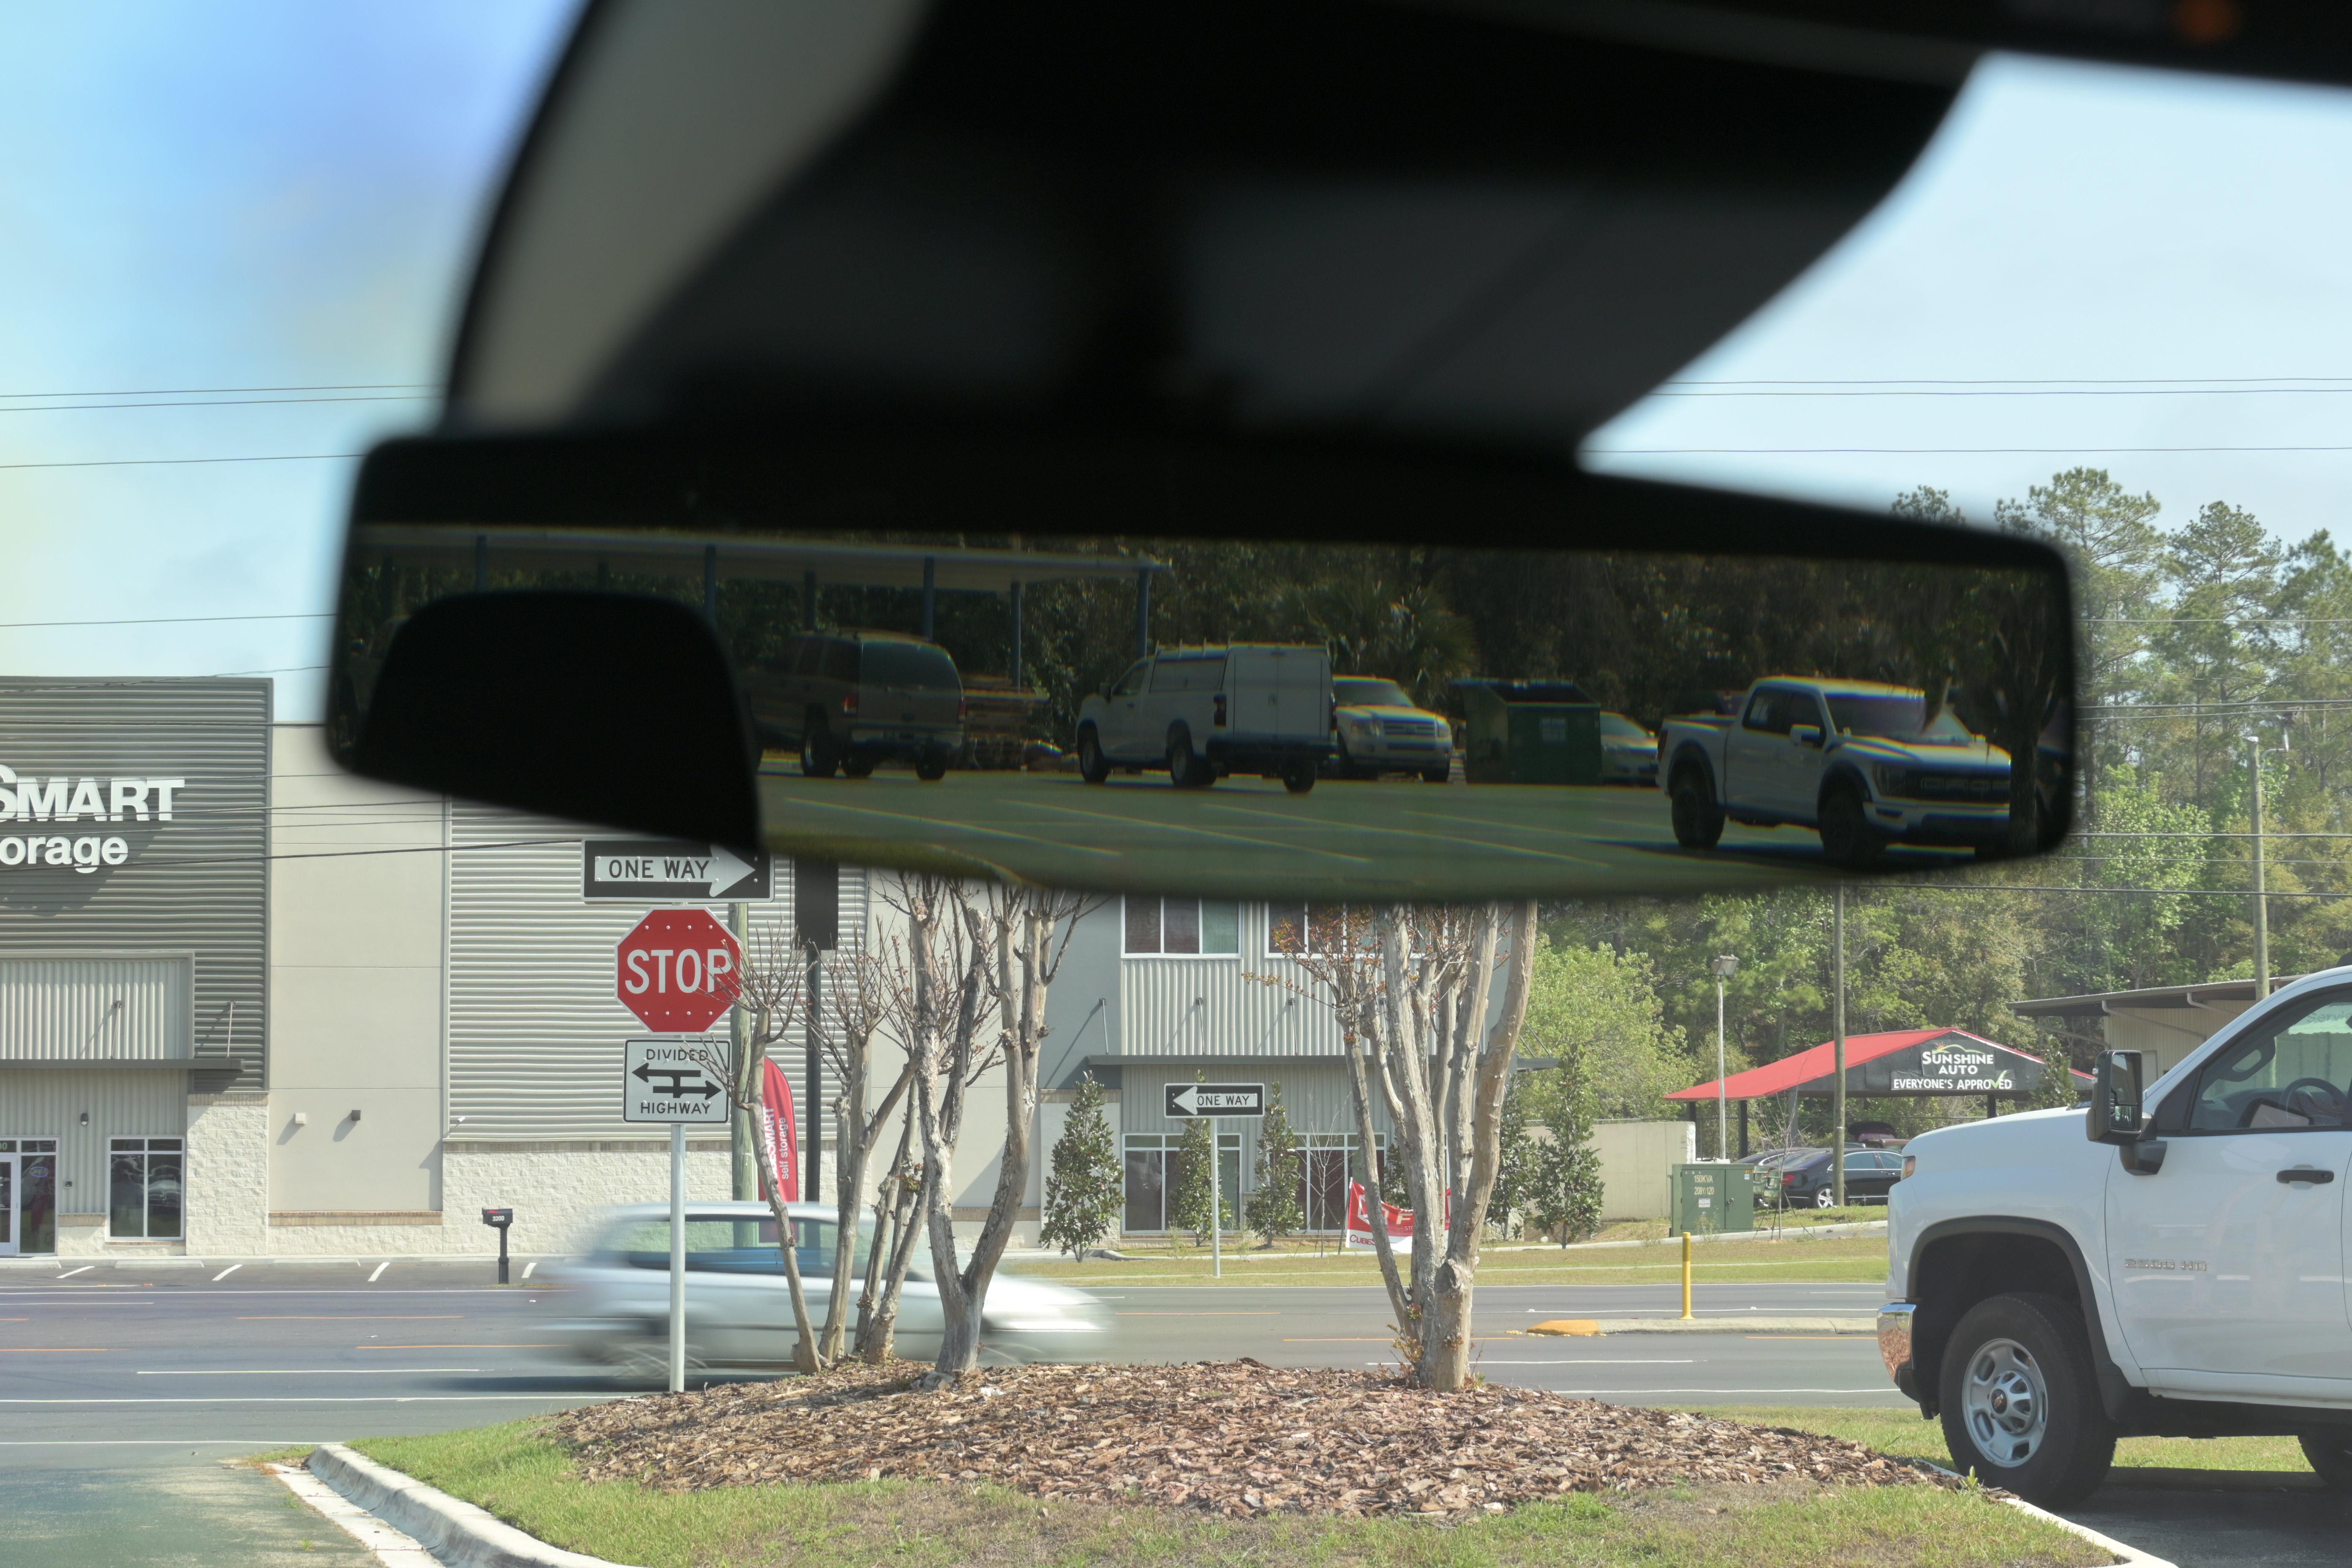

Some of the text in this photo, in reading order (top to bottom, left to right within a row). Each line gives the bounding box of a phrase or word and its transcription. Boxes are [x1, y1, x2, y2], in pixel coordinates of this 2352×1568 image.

[609, 859, 710, 879] ONE WAY
[625, 949, 732, 994] STOP
[646, 1049, 708, 1061] DIVIDED
[1922, 1051, 1993, 1064] SUNSHINE
[1938, 1065, 1978, 1075] AUTO
[1894, 1077, 2012, 1090] EVERYONE'S APPROVED
[1197, 1095, 1250, 1105] ONE WAY
[640, 1102, 712, 1114] HIGHWAY
[779, 1117, 789, 1179] self storage
[1694, 1175, 1713, 1183] 150KVA
[2125, 1258, 2207, 1271] 2500 HD
